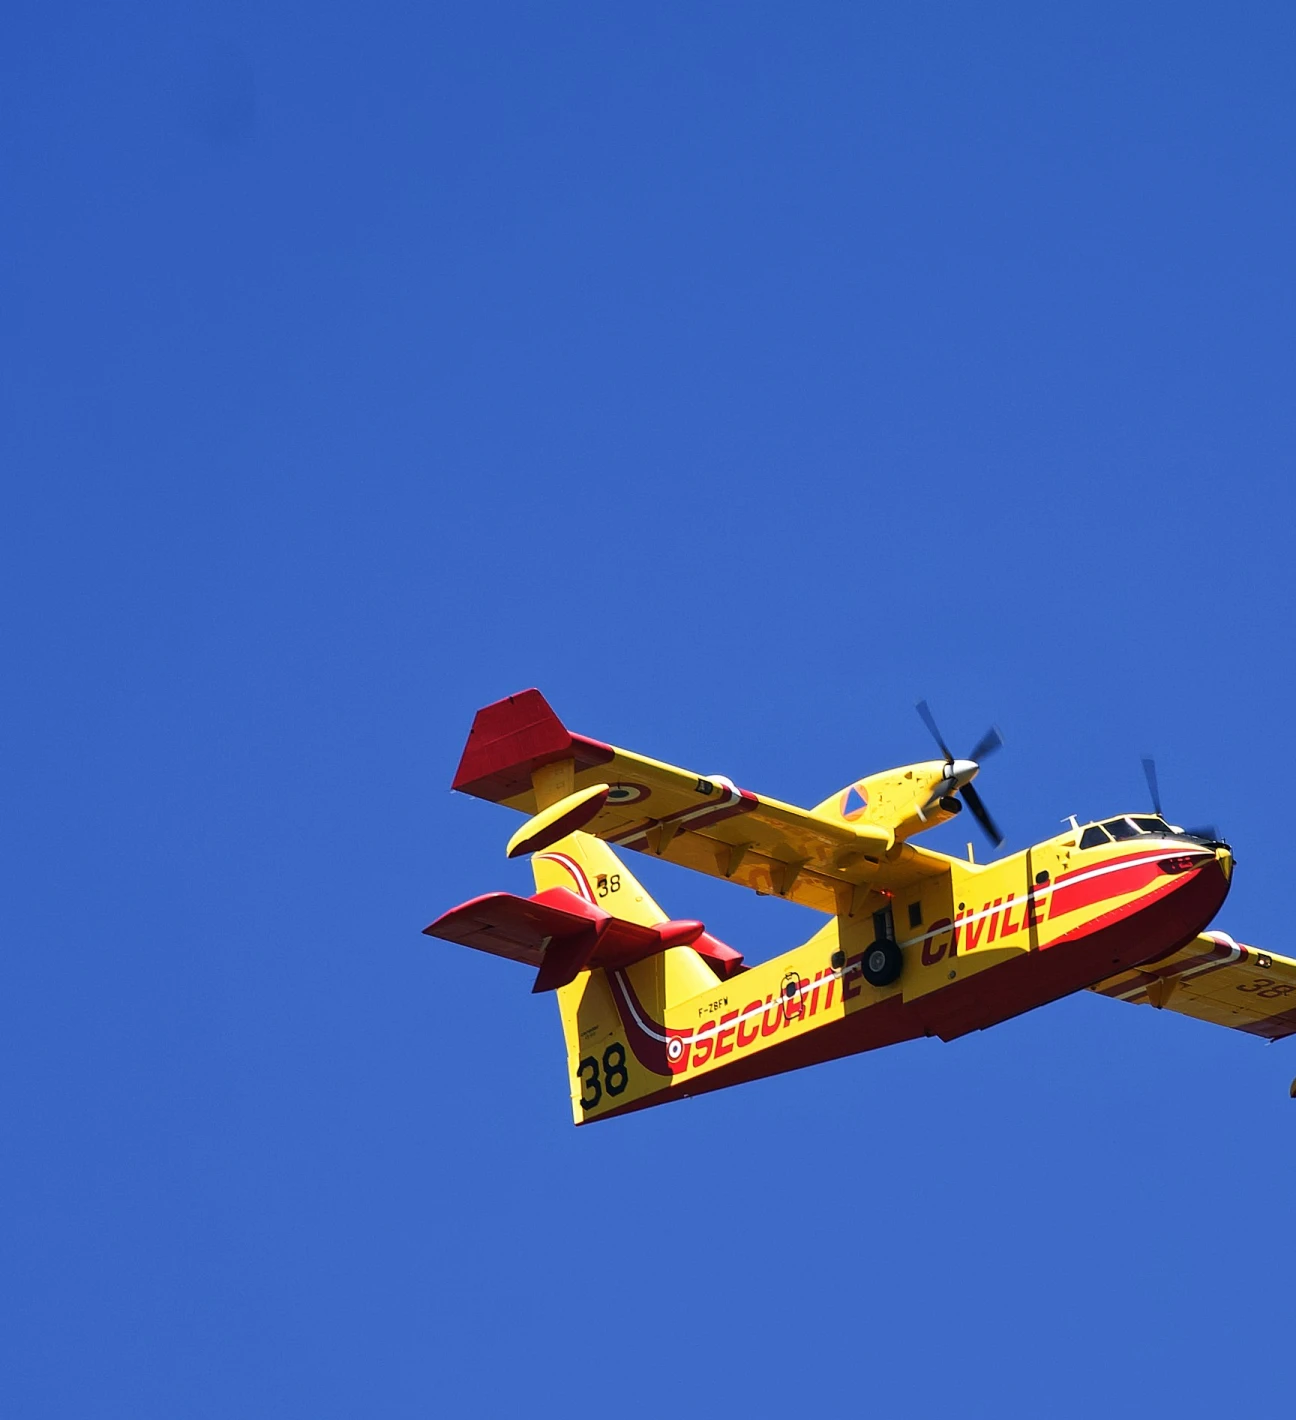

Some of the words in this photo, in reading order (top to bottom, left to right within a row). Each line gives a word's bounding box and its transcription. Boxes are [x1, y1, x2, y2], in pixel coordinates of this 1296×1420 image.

[597, 874, 620, 898] 38
[693, 951, 864, 1068] SECURITE
[921, 878, 1051, 967] CIVILE
[1236, 978, 1296, 999] 38
[577, 1041, 629, 1111] 38
